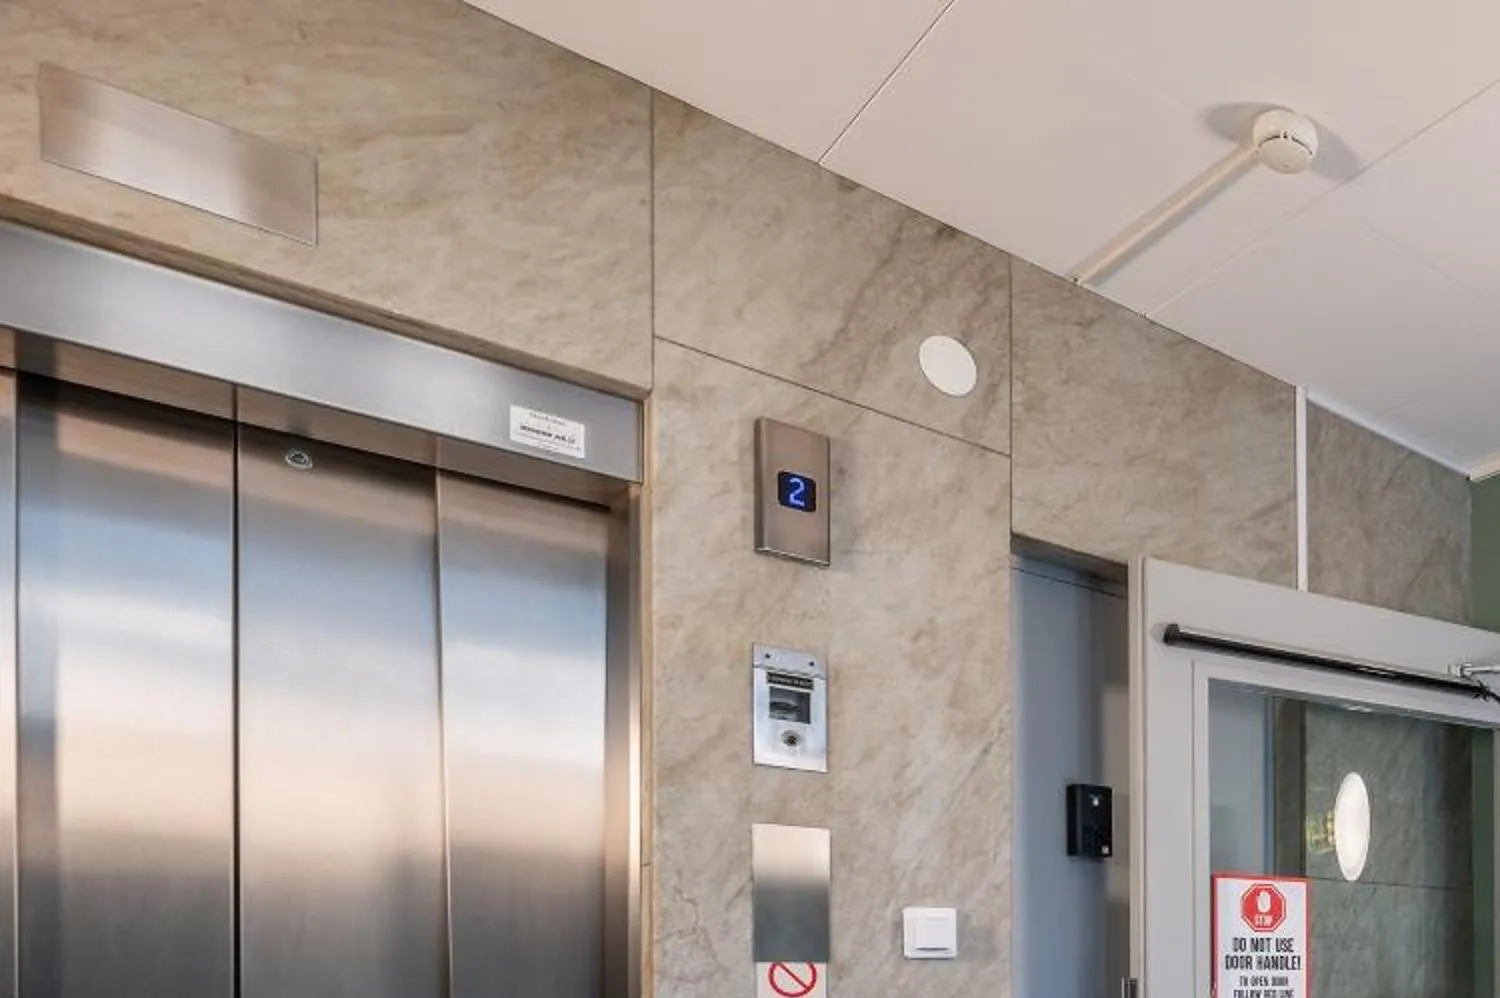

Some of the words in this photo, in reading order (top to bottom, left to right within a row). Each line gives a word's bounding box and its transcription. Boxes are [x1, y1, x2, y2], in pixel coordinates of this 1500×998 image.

[788, 477, 806, 507] 2
[1232, 937, 1247, 953] DO
[1250, 937, 1272, 953] NOT
[1275, 937, 1295, 953] USE
[1225, 955, 1253, 971] DOOR
[1256, 955, 1302, 971] HANDLE!
[1251, 975, 1269, 987] OPEN
